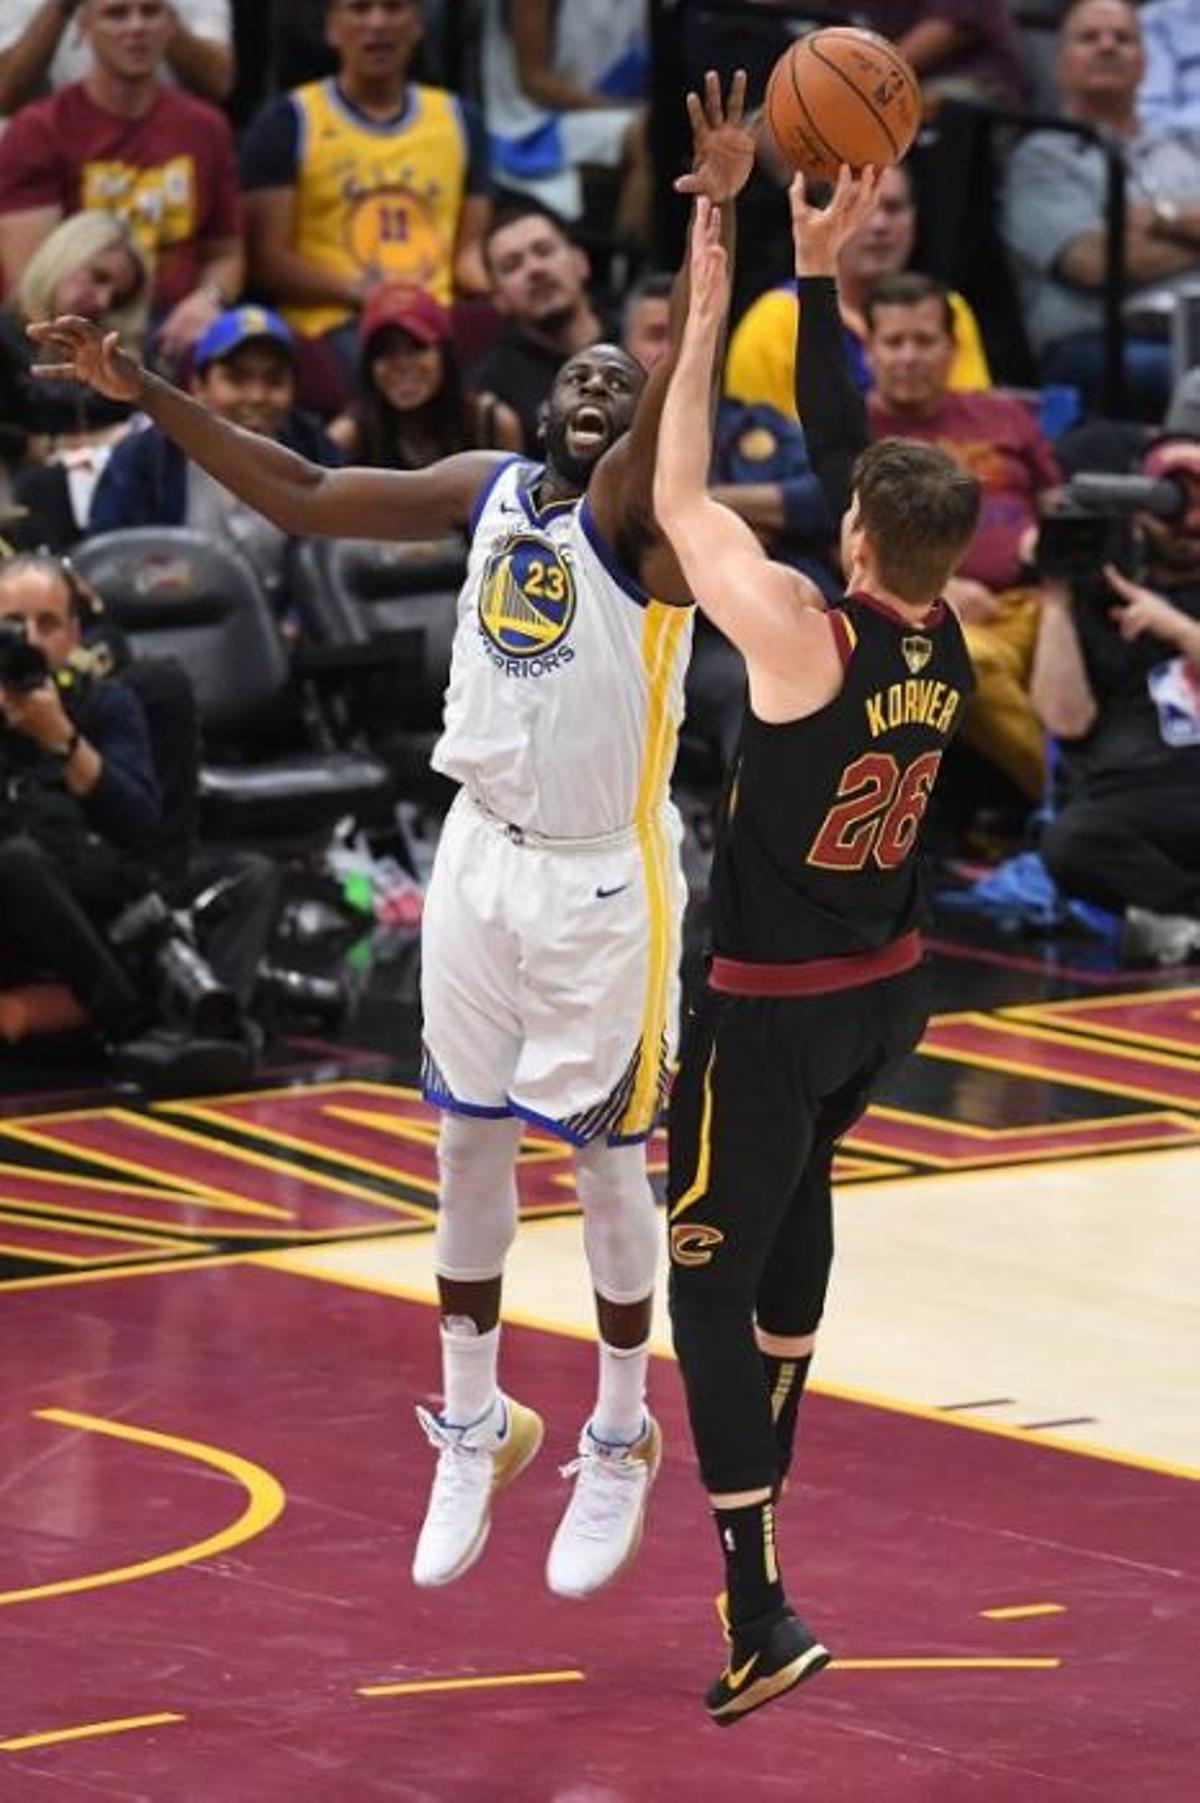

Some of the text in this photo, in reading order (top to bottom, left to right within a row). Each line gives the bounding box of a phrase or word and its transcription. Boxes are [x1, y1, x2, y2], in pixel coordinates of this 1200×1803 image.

[523, 560, 566, 602] 23
[865, 679, 960, 738] KORVER
[806, 749, 943, 871] 26
